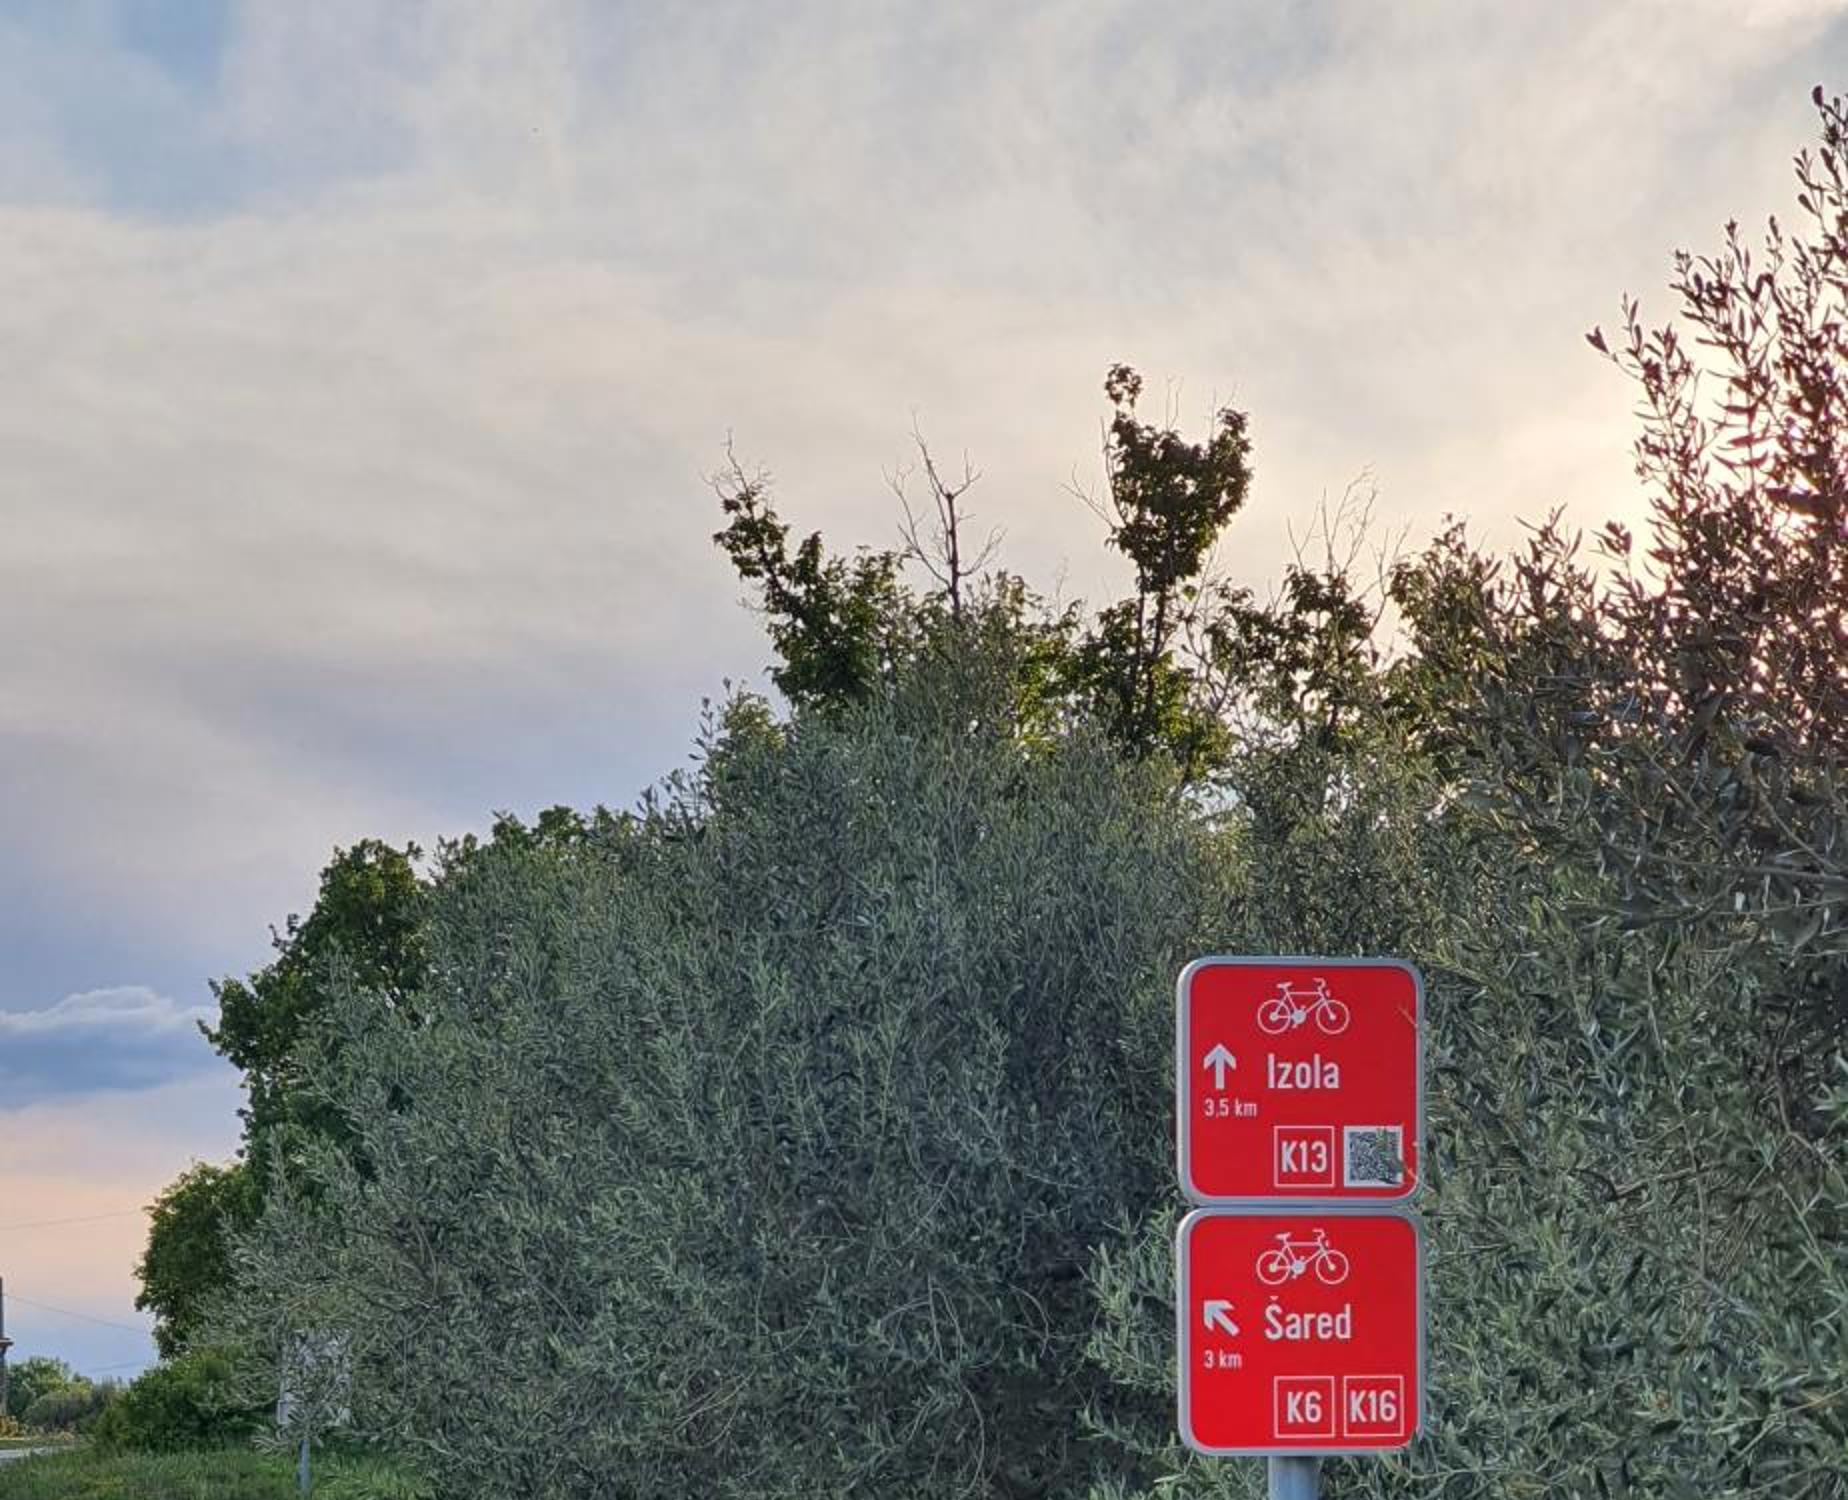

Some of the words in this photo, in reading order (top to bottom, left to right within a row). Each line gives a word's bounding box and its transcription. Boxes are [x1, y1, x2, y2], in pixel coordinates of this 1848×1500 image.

[1266, 1053, 1340, 1089] Izola
[1234, 1098, 1257, 1117] km
[1280, 1140, 1328, 1173] K13
[1264, 1295, 1352, 1341] Šared
[1203, 1350, 1214, 1369] 3
[1219, 1350, 1242, 1369] km
[1286, 1391, 1322, 1423] K6
[1350, 1390, 1397, 1423] K16
